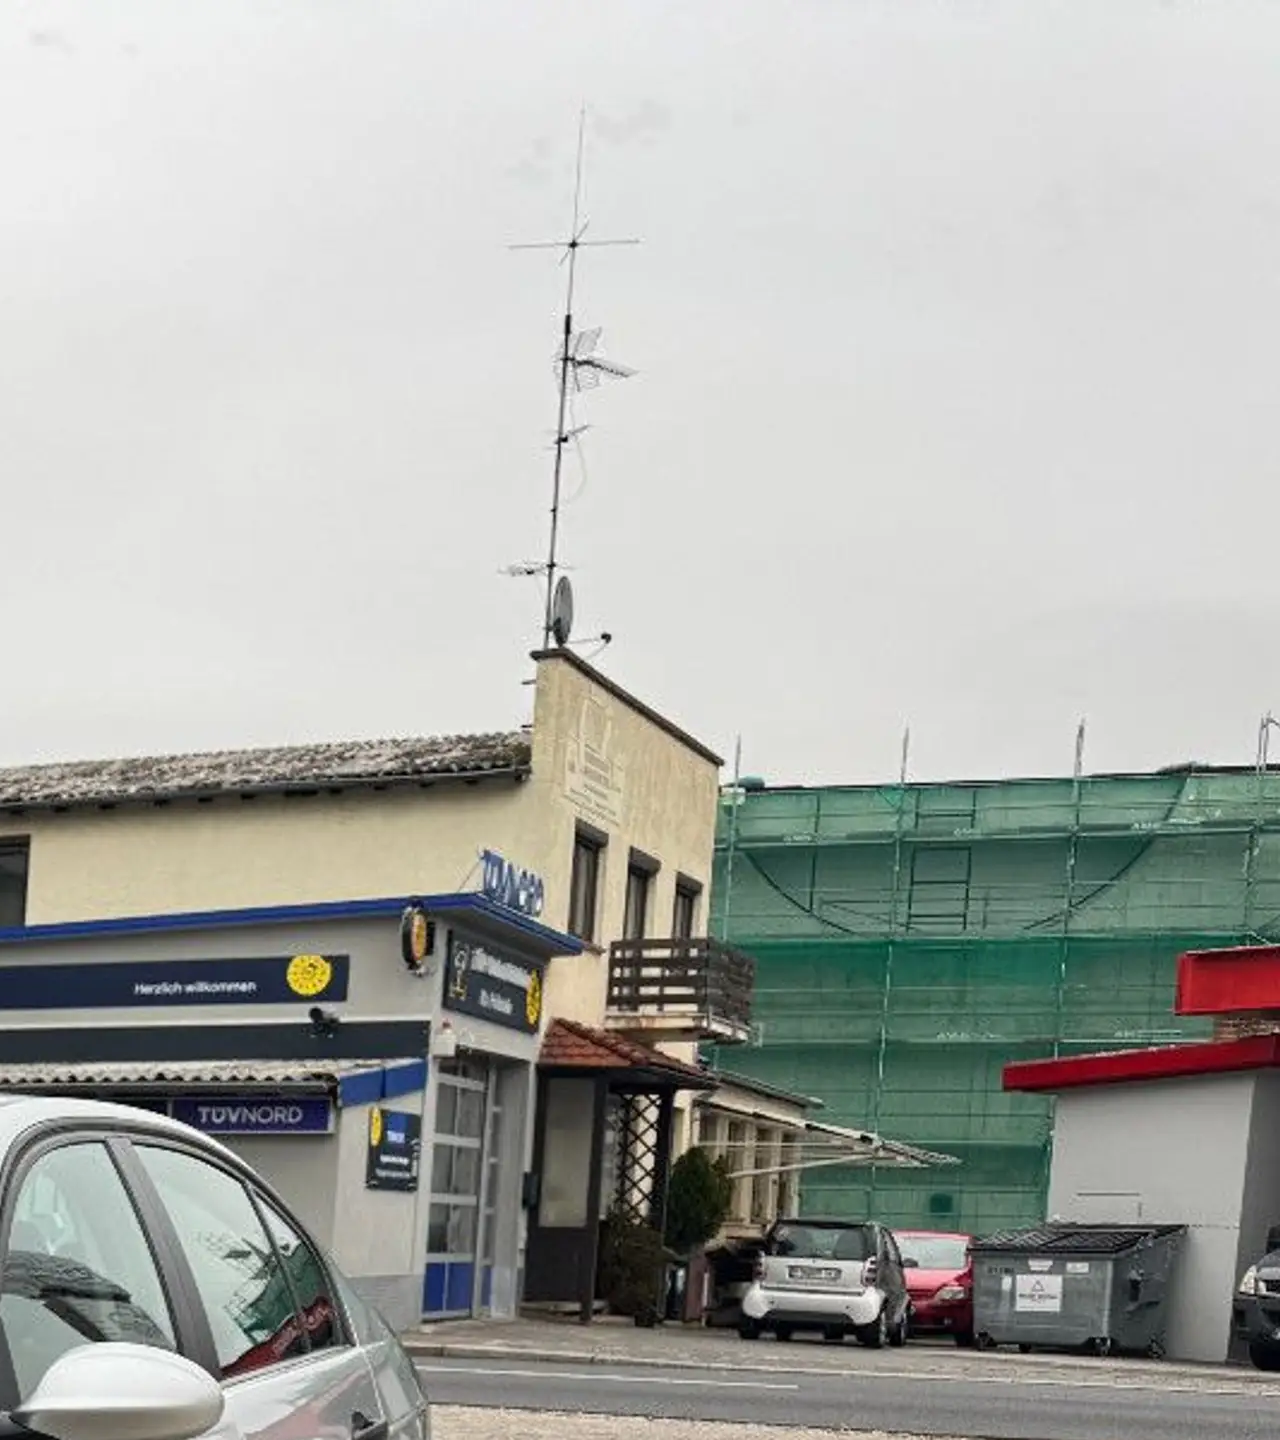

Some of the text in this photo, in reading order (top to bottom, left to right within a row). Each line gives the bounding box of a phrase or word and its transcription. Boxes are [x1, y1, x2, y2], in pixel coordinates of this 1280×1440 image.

[134, 981, 257, 996] Herzlich willkommen
[198, 1105, 303, 1124] TÜVNORD
